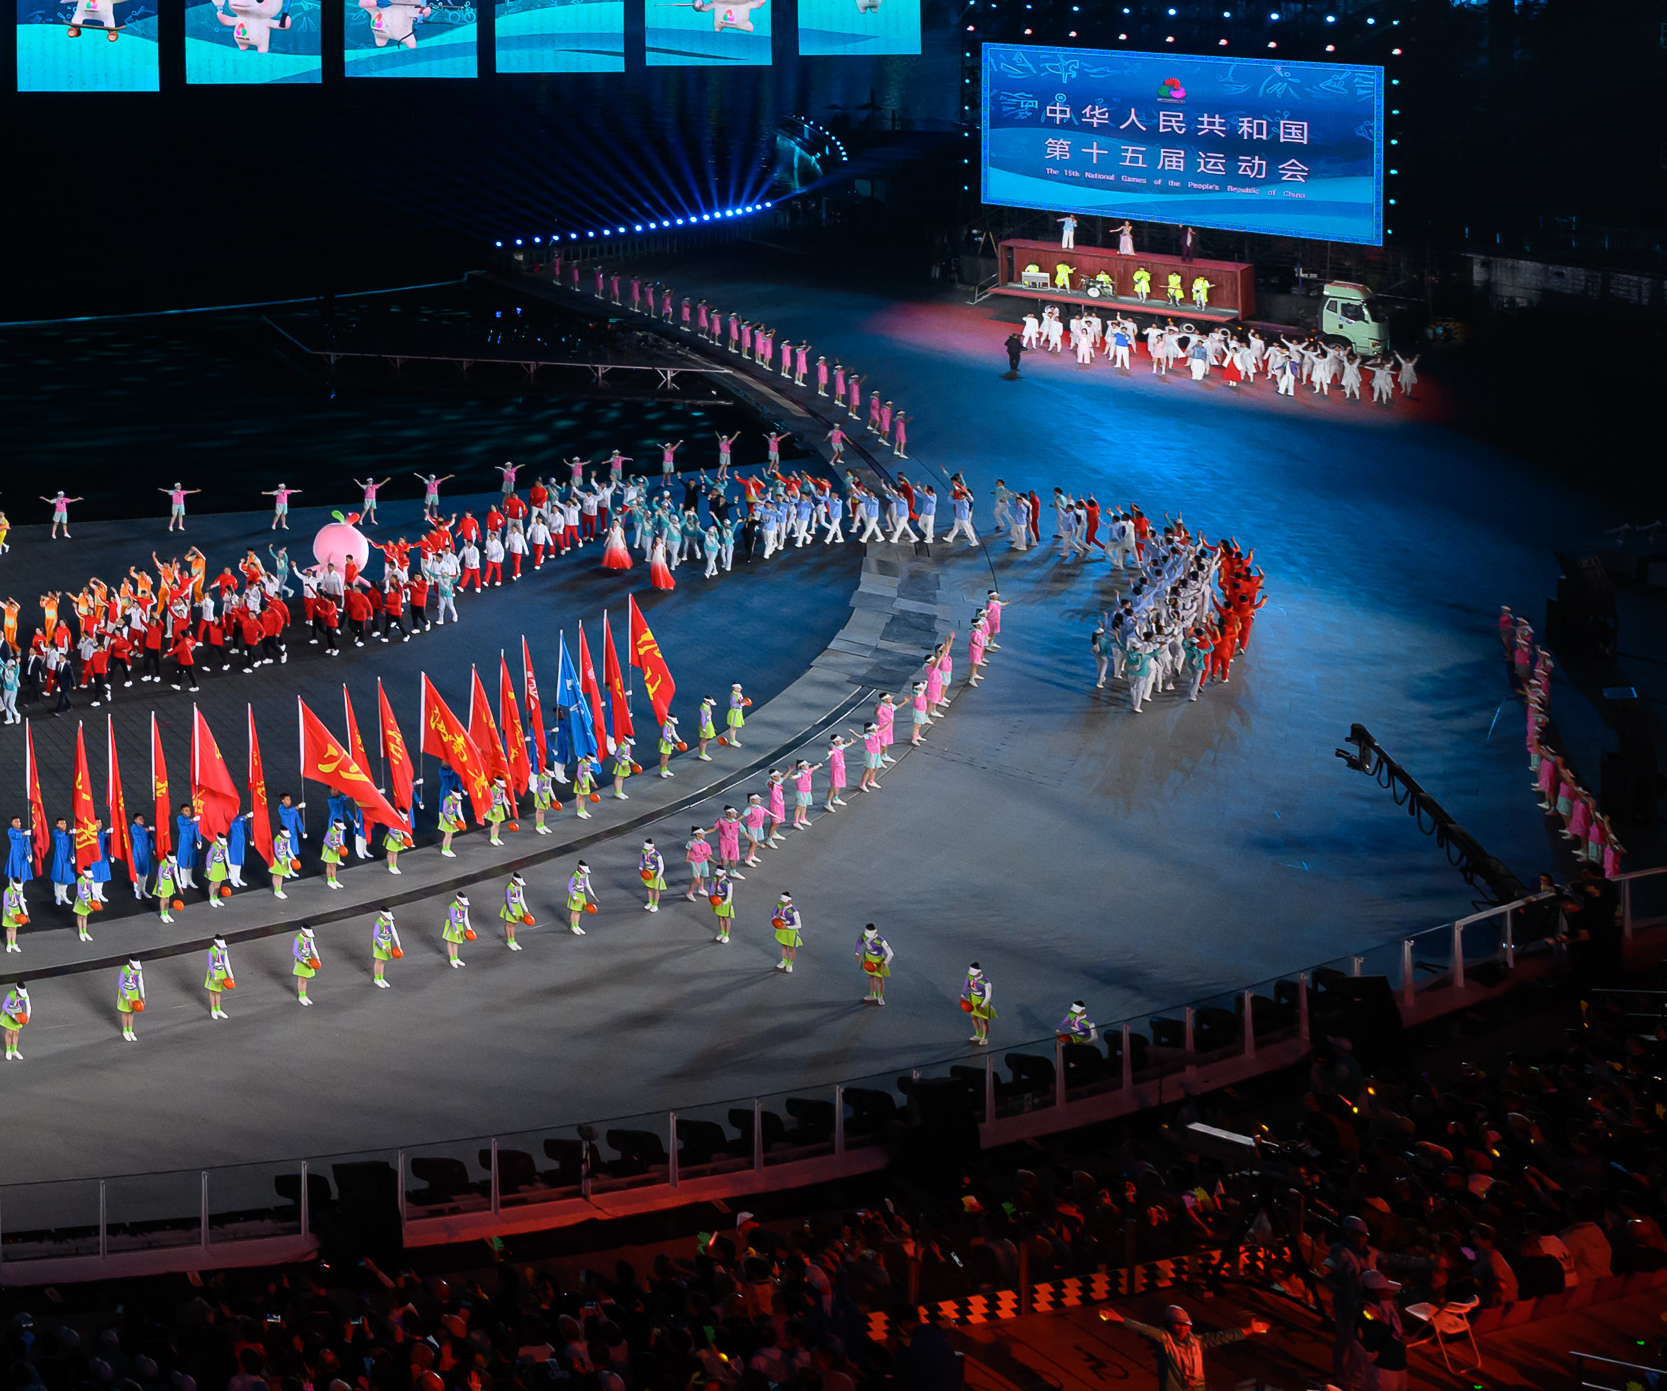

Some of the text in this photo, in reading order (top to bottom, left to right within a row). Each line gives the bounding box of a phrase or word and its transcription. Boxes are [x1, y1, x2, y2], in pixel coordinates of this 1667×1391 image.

[1046, 102, 1308, 145] 中华人民共和国
[1045, 137, 1309, 183] 第十五届运动会
[1046, 167, 1059, 175] The
[1064, 169, 1080, 177] 15th
[1085, 171, 1115, 181] National
[1121, 175, 1147, 184] Games
[1188, 181, 1220, 190] People's
[1227, 185, 1260, 195] Republic
[1283, 190, 1306, 199] China
